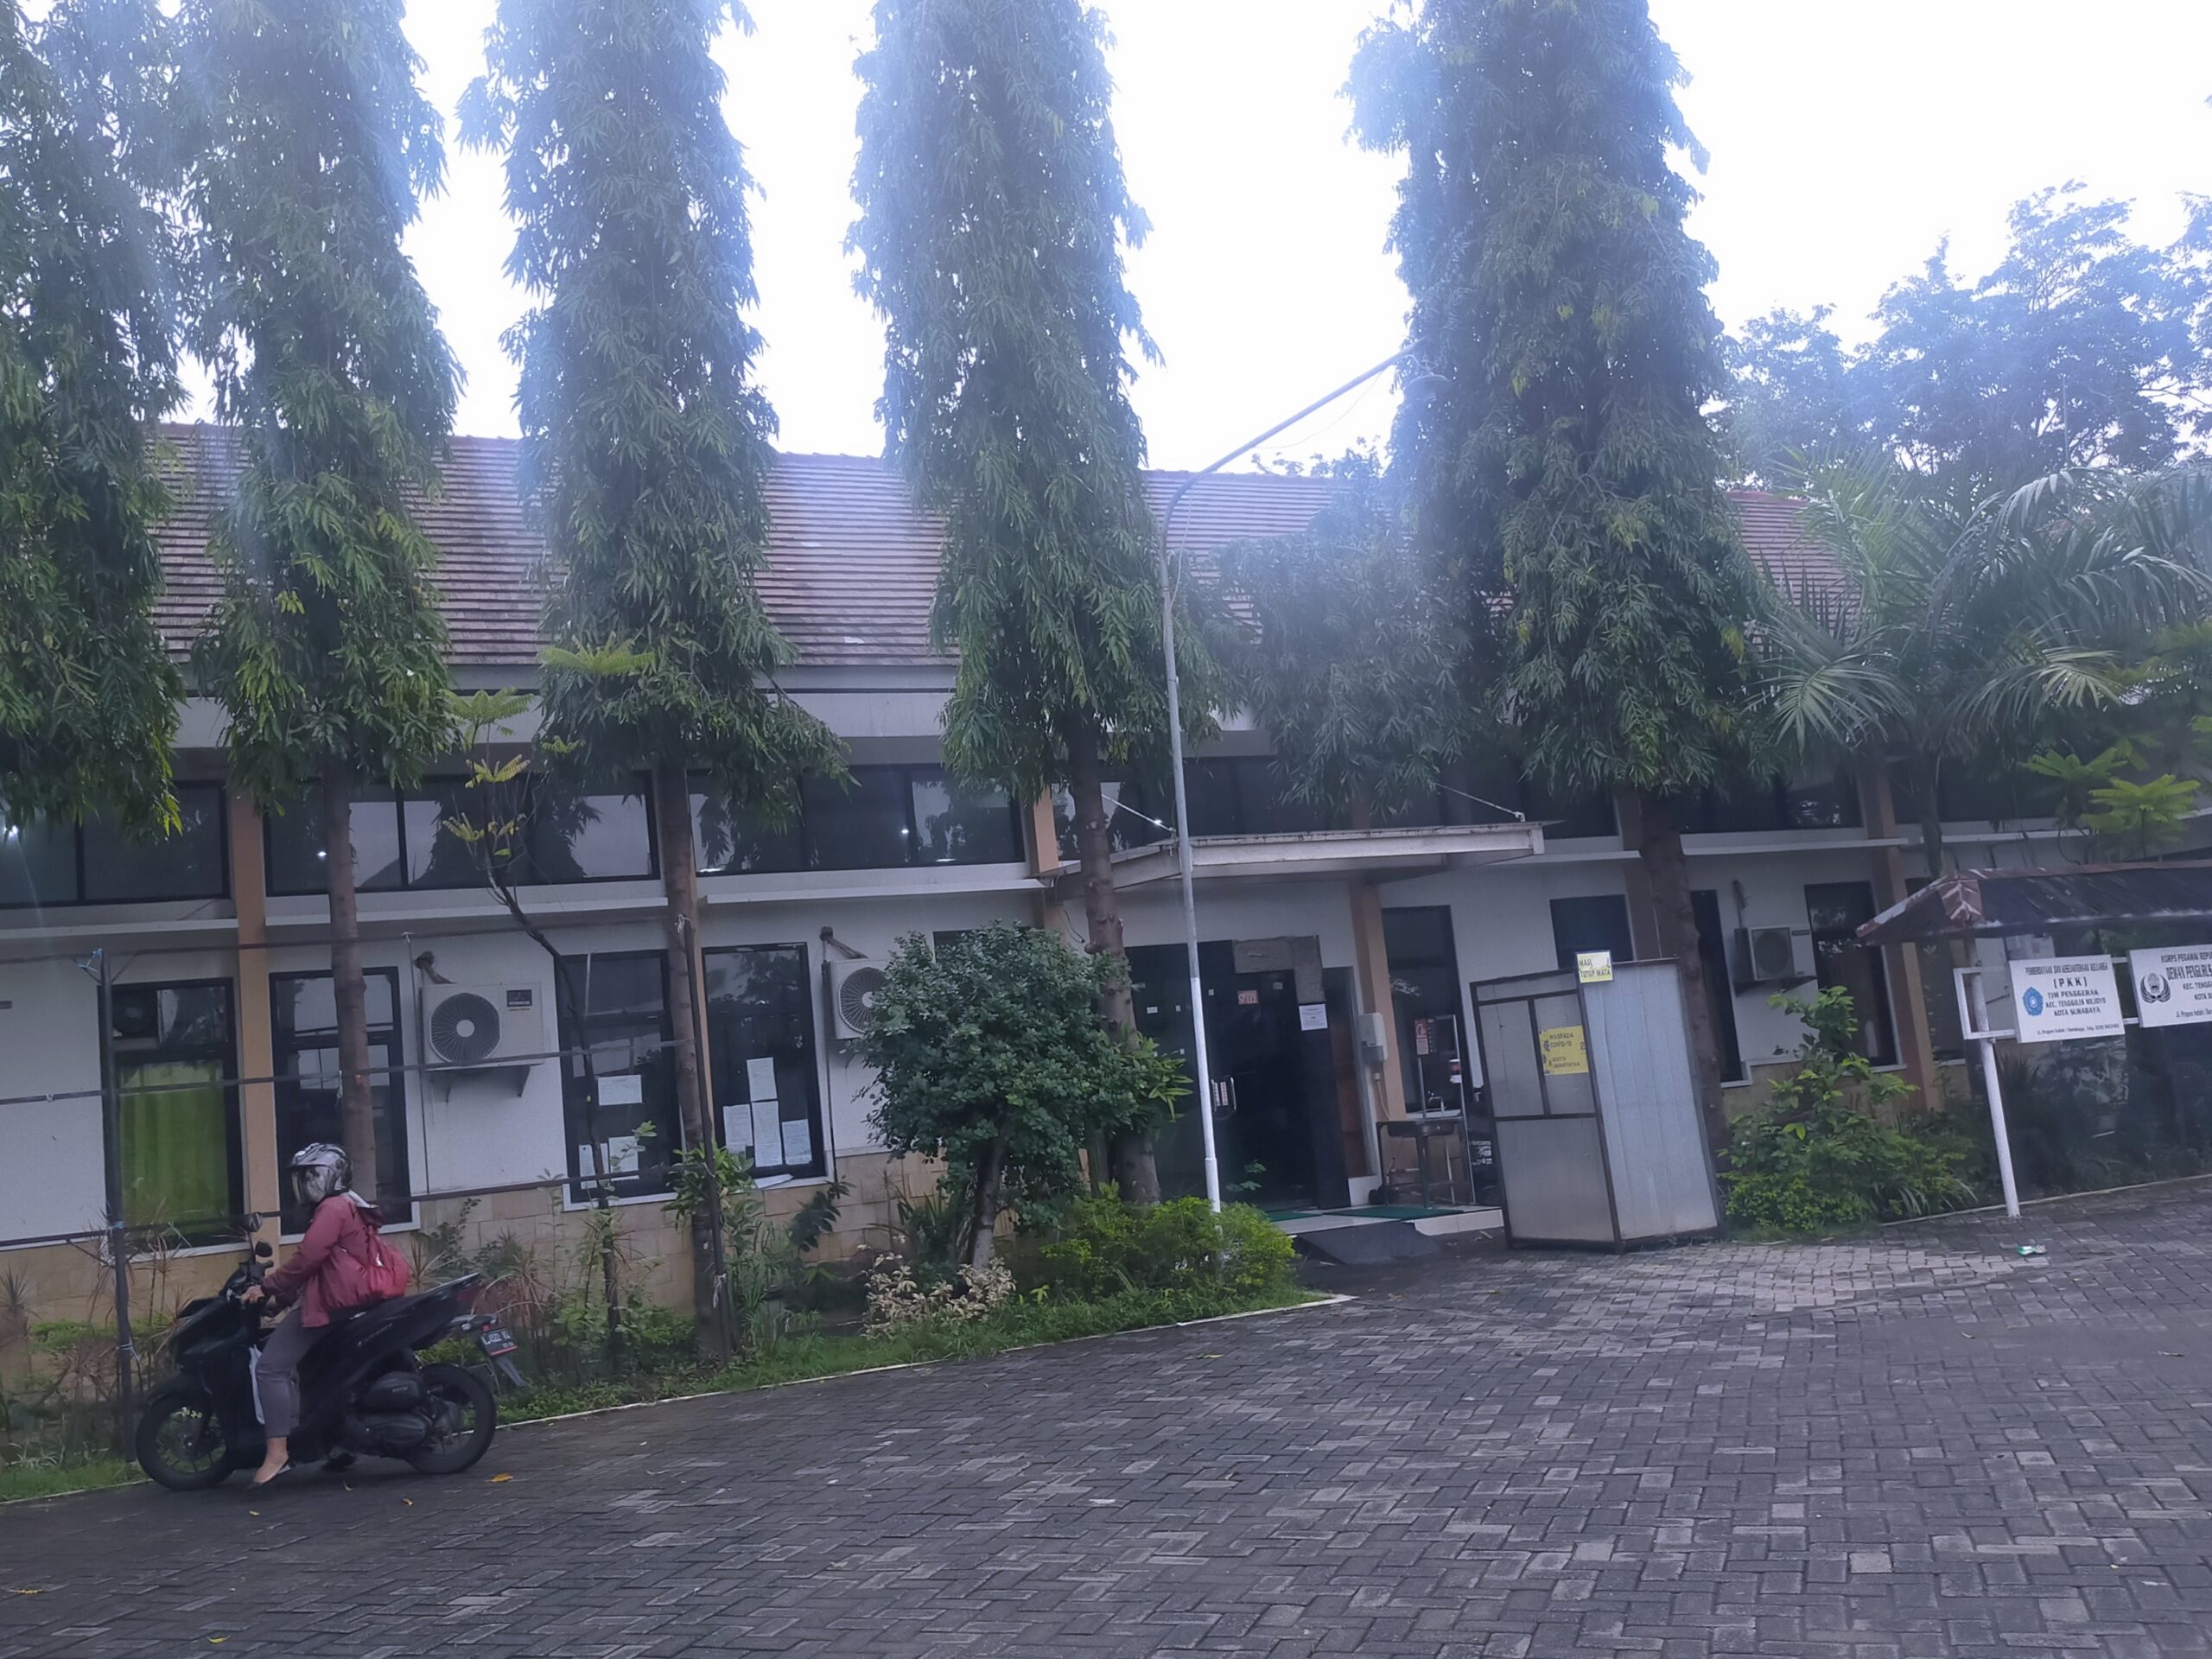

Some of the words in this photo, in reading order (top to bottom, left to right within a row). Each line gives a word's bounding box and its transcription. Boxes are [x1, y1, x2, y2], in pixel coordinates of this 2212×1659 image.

[2161, 954, 2177, 963] KORPS
[2177, 953, 2198, 962] PEGAWAI
[2166, 966, 2185, 980] DEWAN
[2061, 988, 2099, 998] PENGGERAK
[2058, 999, 2085, 1007] TENGGILIS
[2069, 1007, 2101, 1015] SURABAYA
